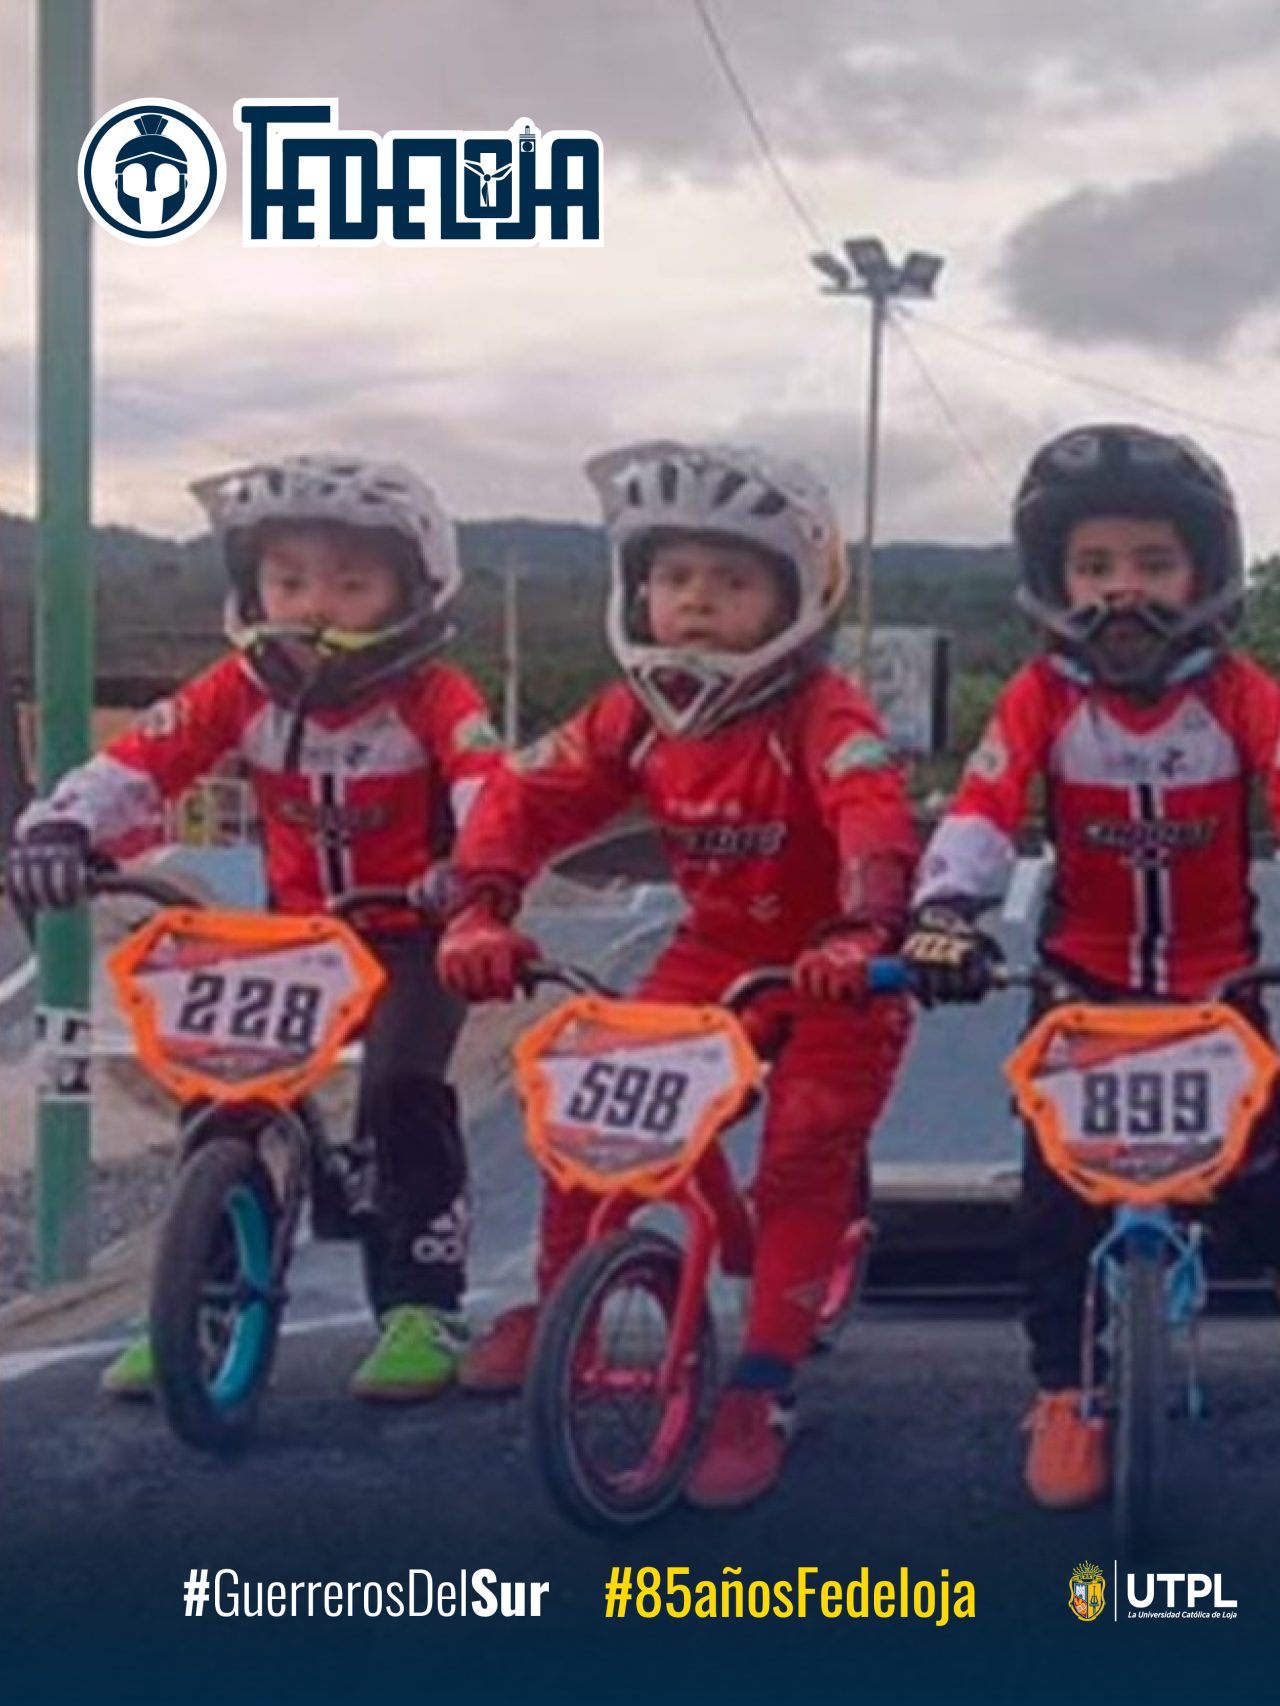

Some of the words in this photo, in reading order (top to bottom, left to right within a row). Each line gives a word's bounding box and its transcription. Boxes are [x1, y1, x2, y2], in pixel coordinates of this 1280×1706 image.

[176, 971, 322, 1045] 228
[567, 1060, 690, 1133] 598
[1082, 1070, 1208, 1136] 899
